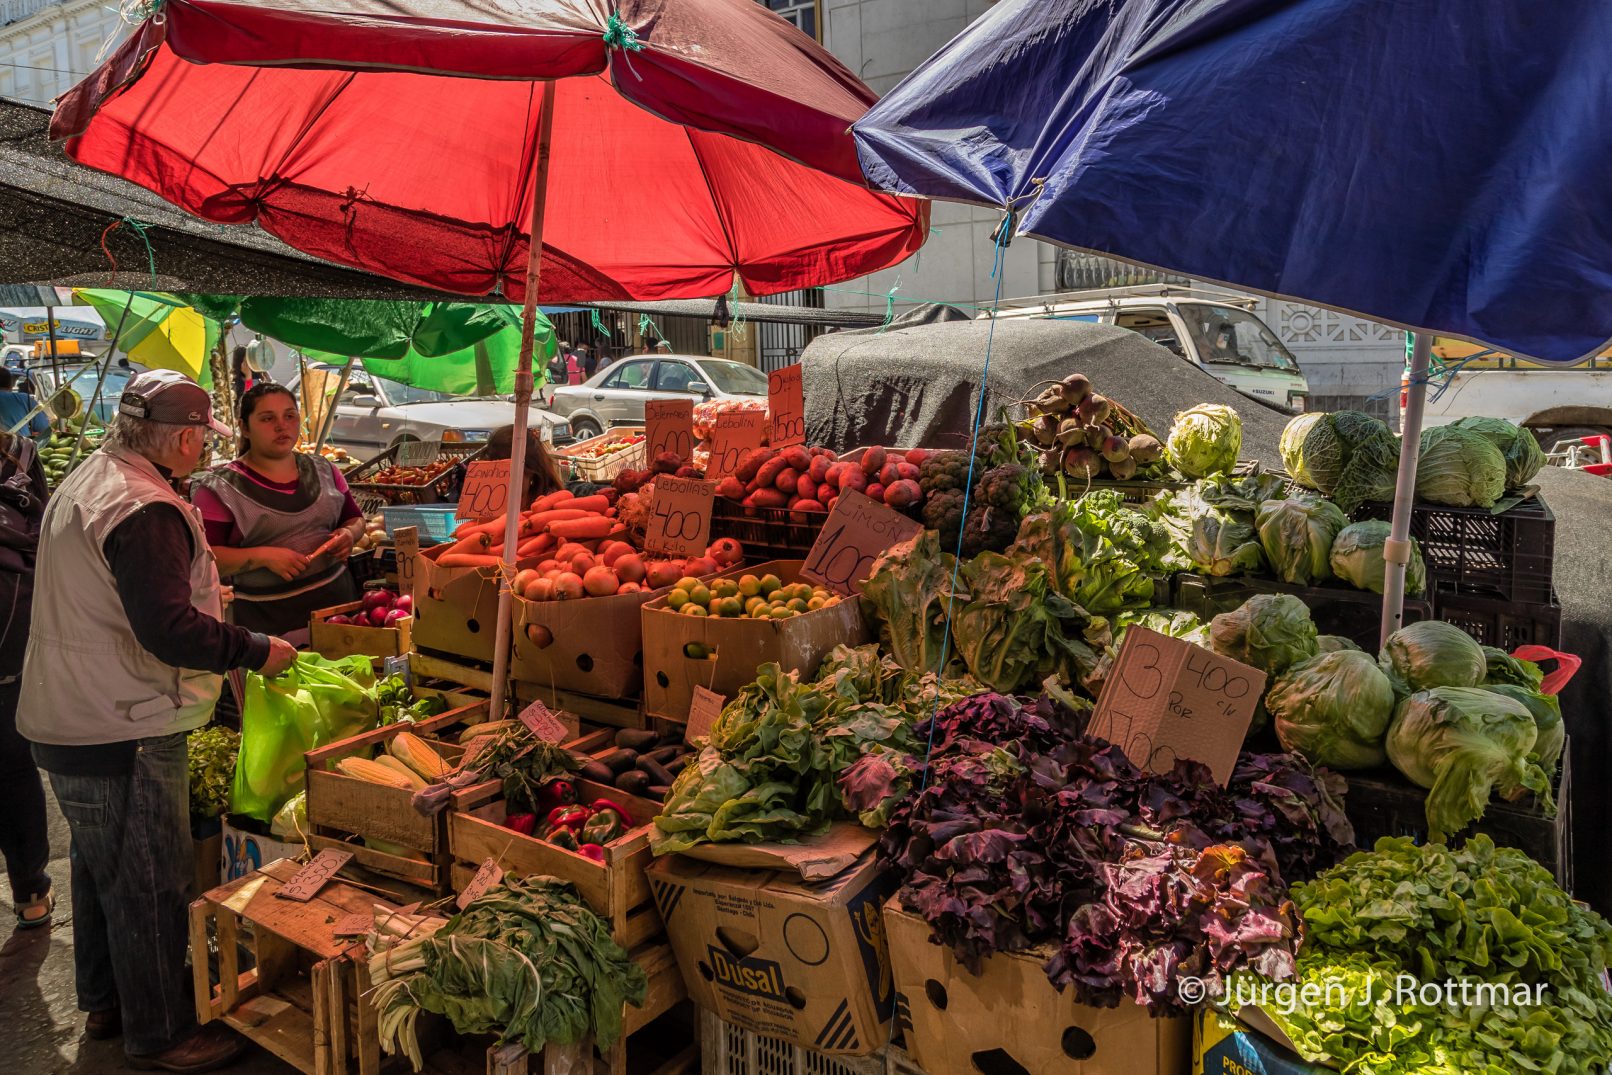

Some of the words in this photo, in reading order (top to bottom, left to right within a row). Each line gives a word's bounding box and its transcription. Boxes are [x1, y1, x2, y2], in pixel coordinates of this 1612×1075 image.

[61, 326, 97, 336] LIGHT
[1255, 388, 1275, 396] SUZUKI
[773, 410, 804, 443] 1500
[714, 439, 752, 474] 40
[464, 481, 507, 513] 400
[655, 500, 702, 541] 400
[1120, 643, 1163, 700] 3
[1186, 653, 1250, 699] 400
[302, 859, 338, 885] 350
[713, 951, 781, 996] Dusal
